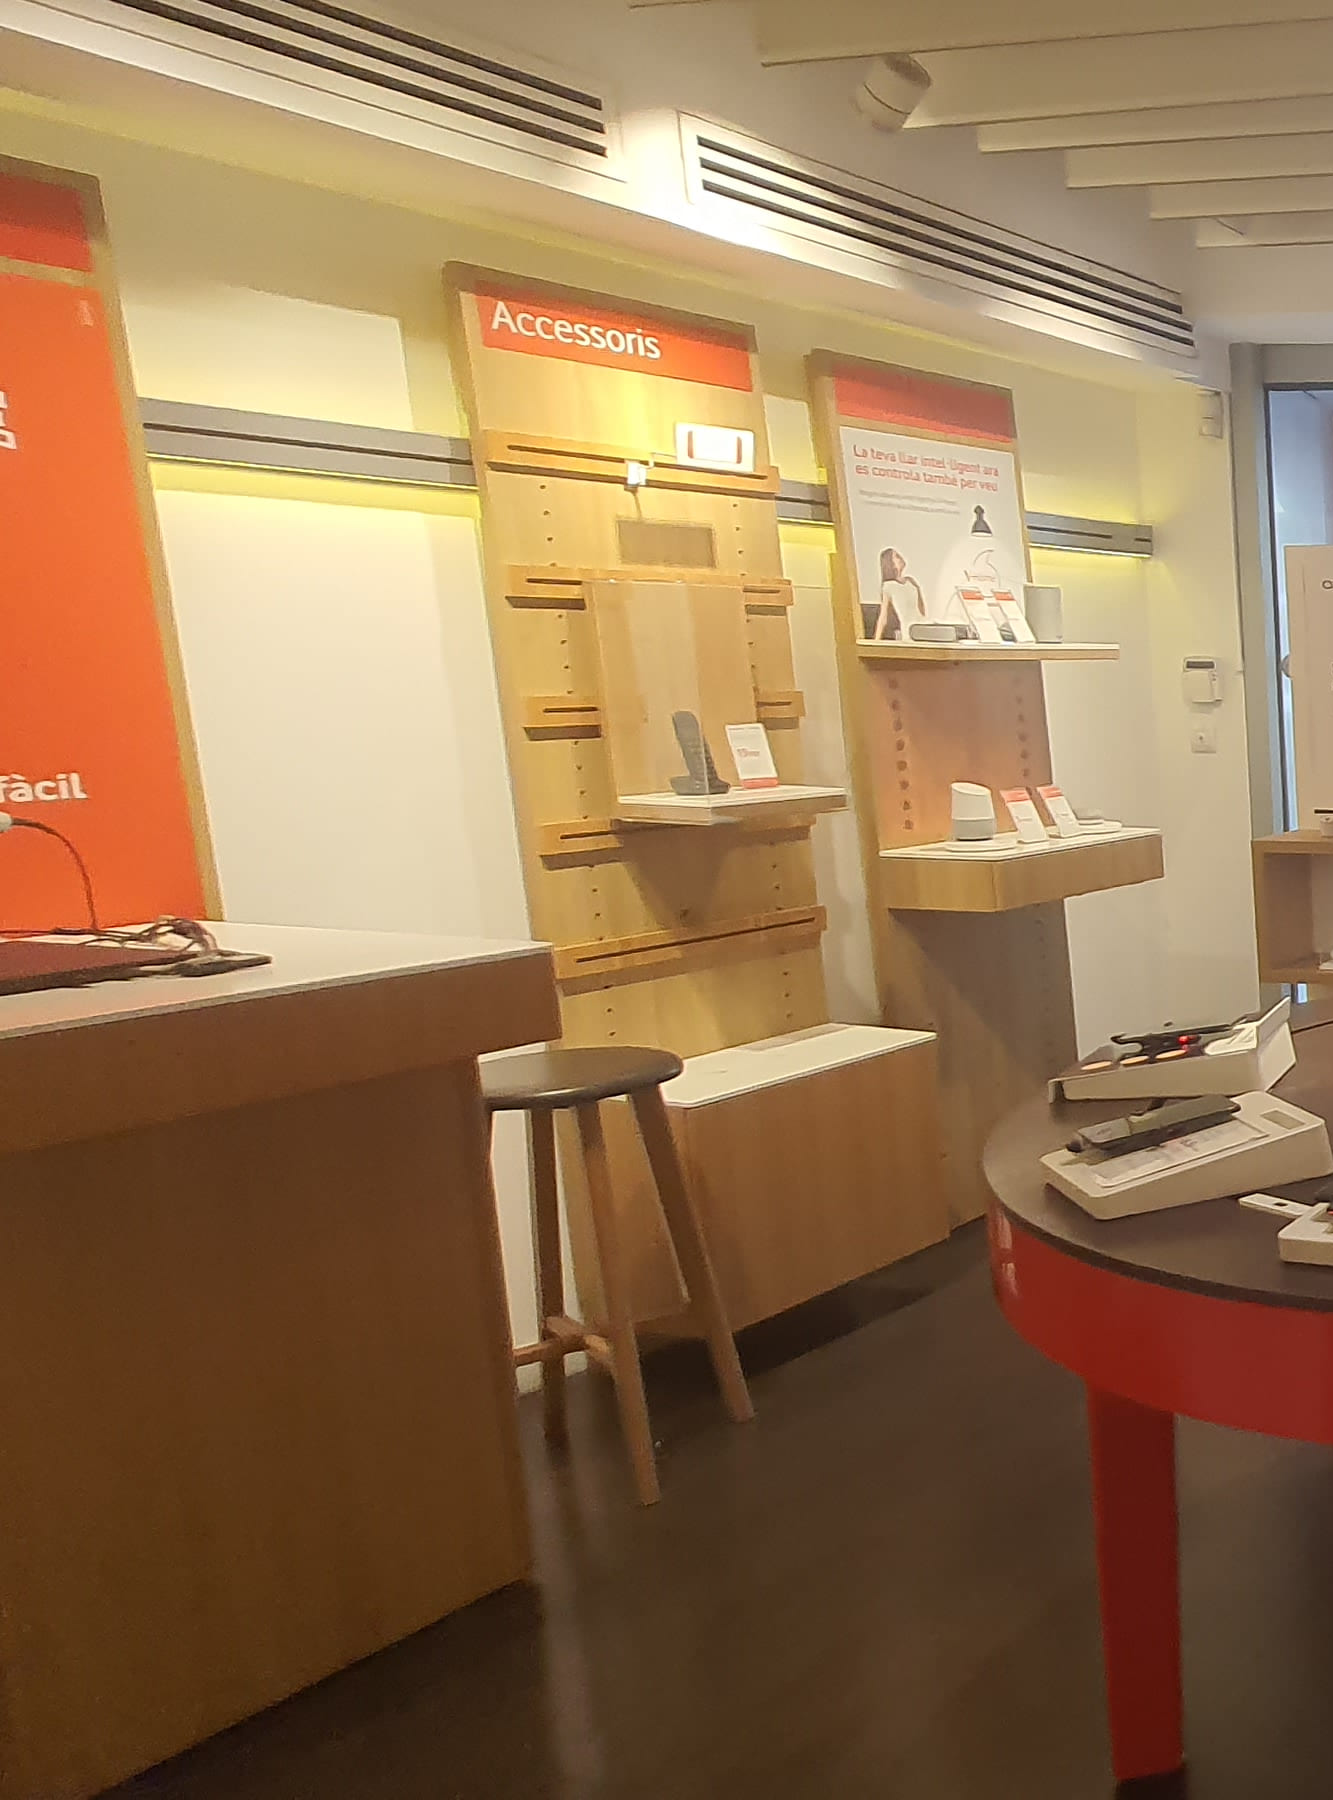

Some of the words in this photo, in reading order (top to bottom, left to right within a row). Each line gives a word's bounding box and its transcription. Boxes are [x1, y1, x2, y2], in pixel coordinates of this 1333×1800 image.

[491, 300, 661, 359] Accessoris
[853, 445, 867, 458] La
[870, 448, 896, 462] teva
[899, 451, 918, 465] llar
[982, 465, 999, 476] ara
[855, 464, 869, 475] es
[872, 466, 921, 482] controla
[960, 478, 977, 489] per
[979, 481, 998, 492] veu
